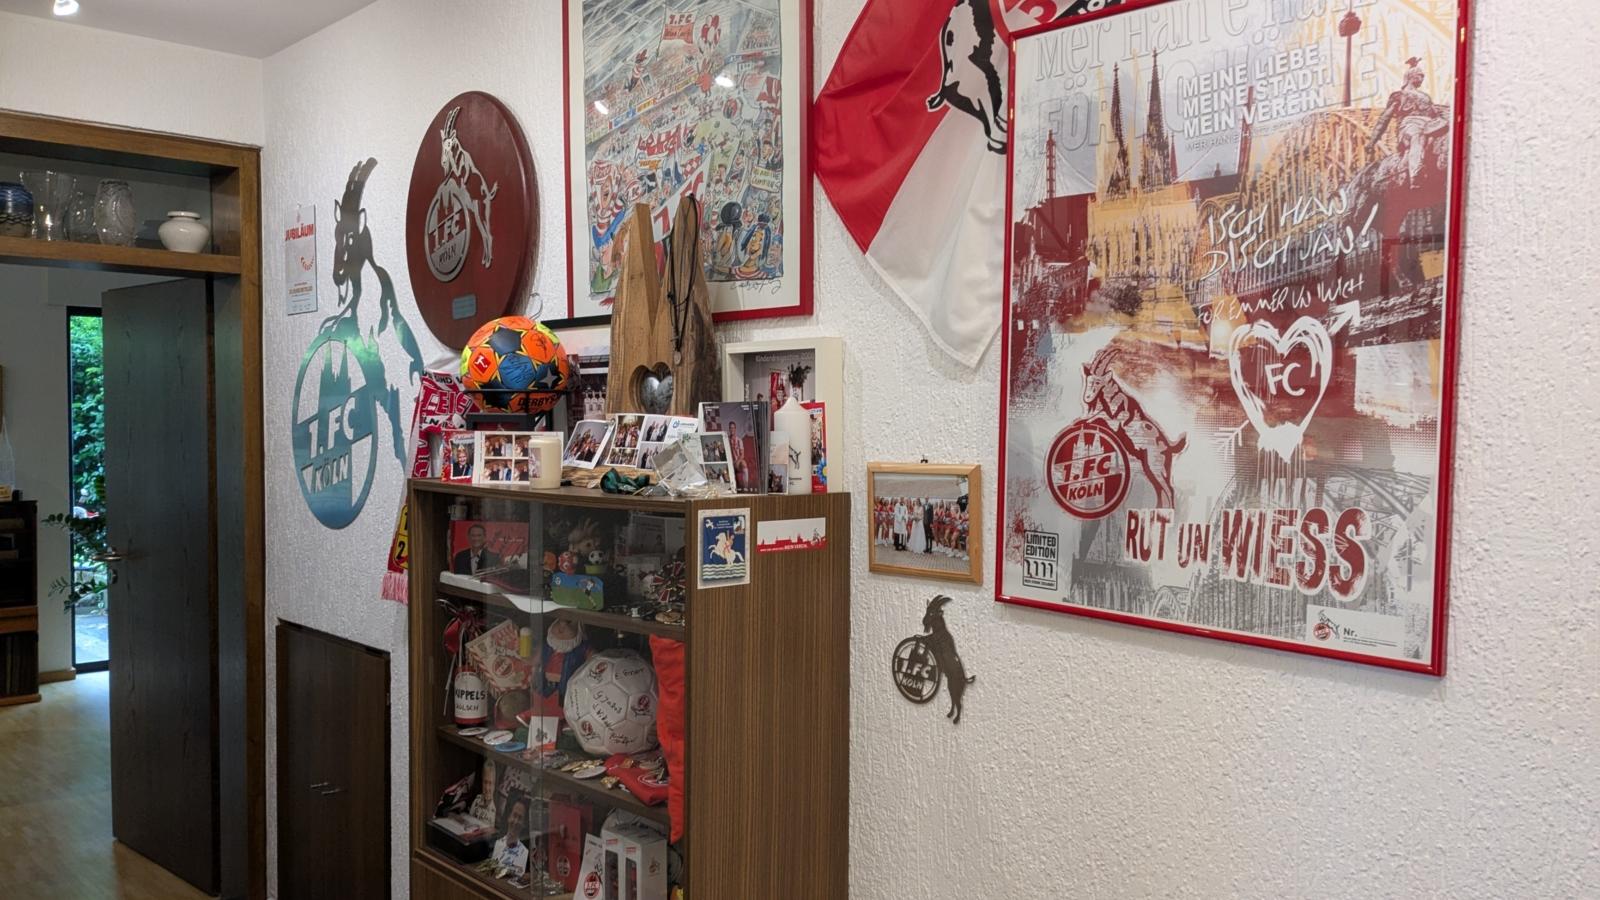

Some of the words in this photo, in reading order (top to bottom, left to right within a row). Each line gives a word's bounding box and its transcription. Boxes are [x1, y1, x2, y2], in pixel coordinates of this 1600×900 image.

[1183, 63, 1247, 98] MEINE
[1183, 86, 1247, 119] MEINE
[1183, 109, 1235, 139] MEIN
[285, 223, 316, 241] JUBILÄUM
[1208, 204, 1268, 245] ISCH
[1200, 233, 1291, 281] DISCH
[1265, 362, 1306, 396] FC
[1063, 455, 1112, 483] 1.FC
[1068, 482, 1105, 501] KÖLN
[1025, 545, 1056, 559] EDITION
[1026, 532, 1057, 547] LIMITED
[1124, 507, 1174, 563] RUT
[1177, 522, 1212, 570] UN
[1219, 507, 1371, 598] WIESS
[1343, 627, 1358, 637] Nr.
